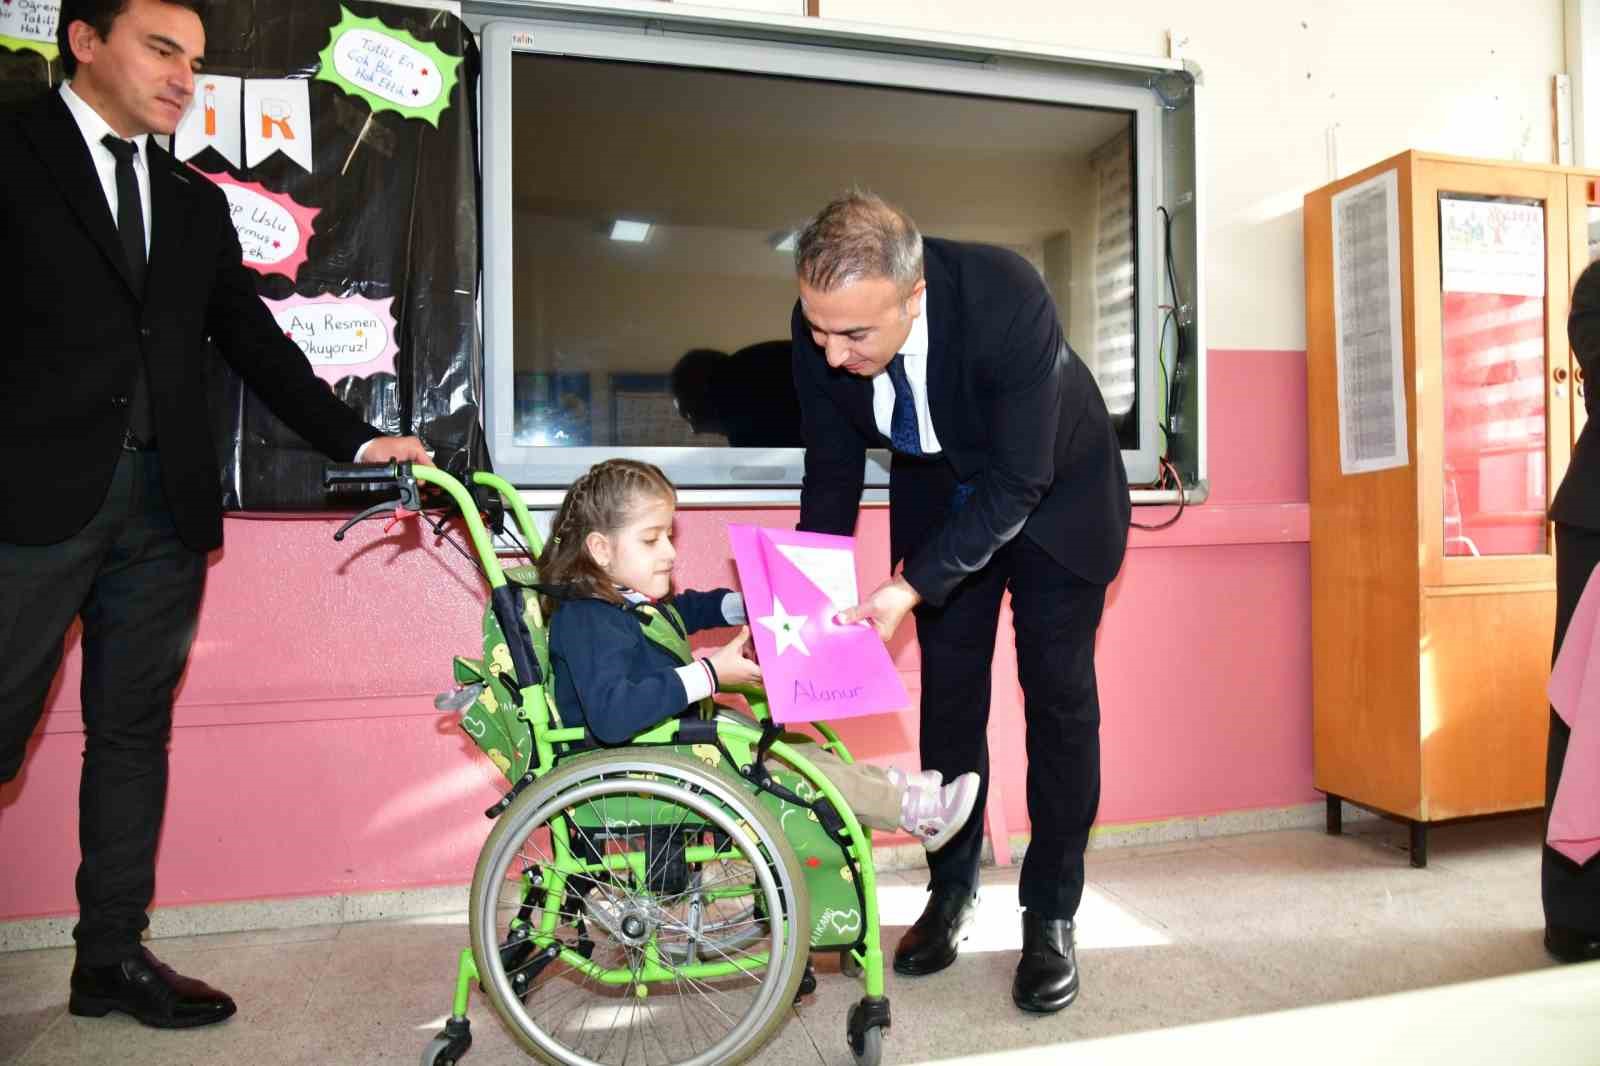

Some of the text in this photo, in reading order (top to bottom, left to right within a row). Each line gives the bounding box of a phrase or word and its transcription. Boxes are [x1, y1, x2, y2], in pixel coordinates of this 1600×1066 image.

[290, 313, 377, 336] Ay Resmen
[793, 679, 864, 705] Alanur
